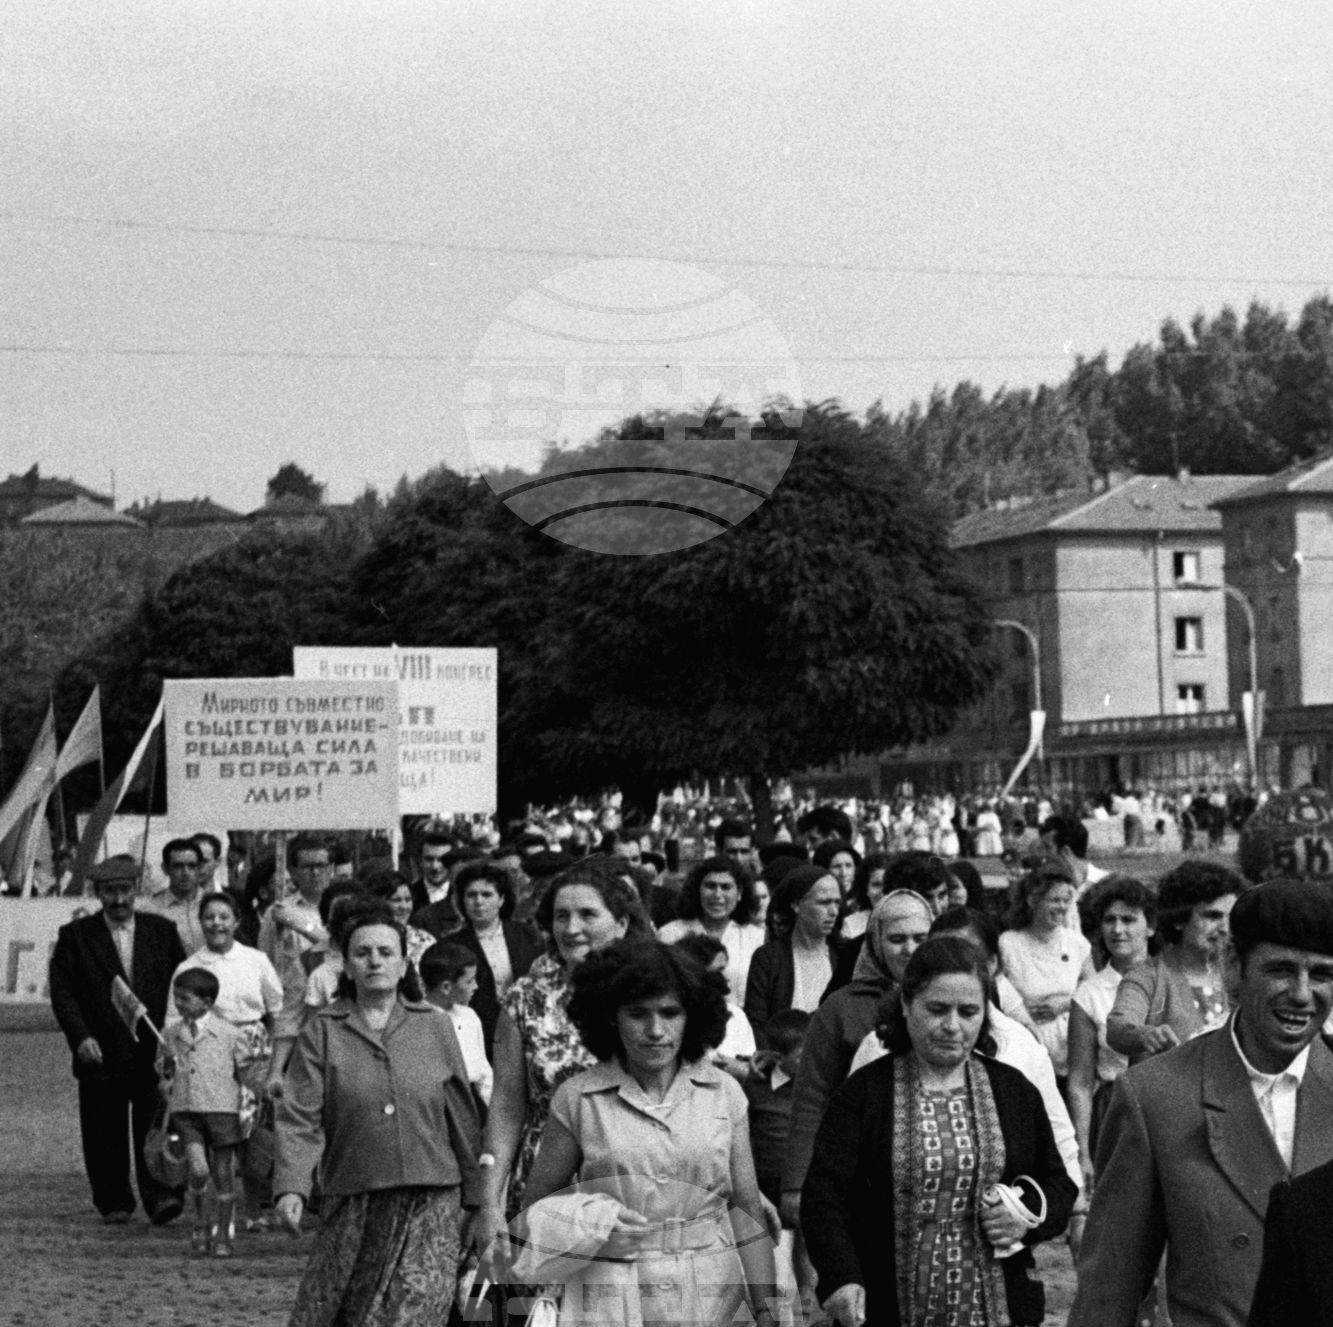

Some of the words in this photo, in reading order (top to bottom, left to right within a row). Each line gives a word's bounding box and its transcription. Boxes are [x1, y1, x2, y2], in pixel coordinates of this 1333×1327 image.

[185, 740, 305, 759] РЕШАВАЩА
[315, 739, 377, 754] СИЛА
[186, 762, 200, 779] В
[220, 761, 341, 778] БОРБАТА
[349, 760, 378, 776] ЗА
[243, 782, 322, 803] МИР!
